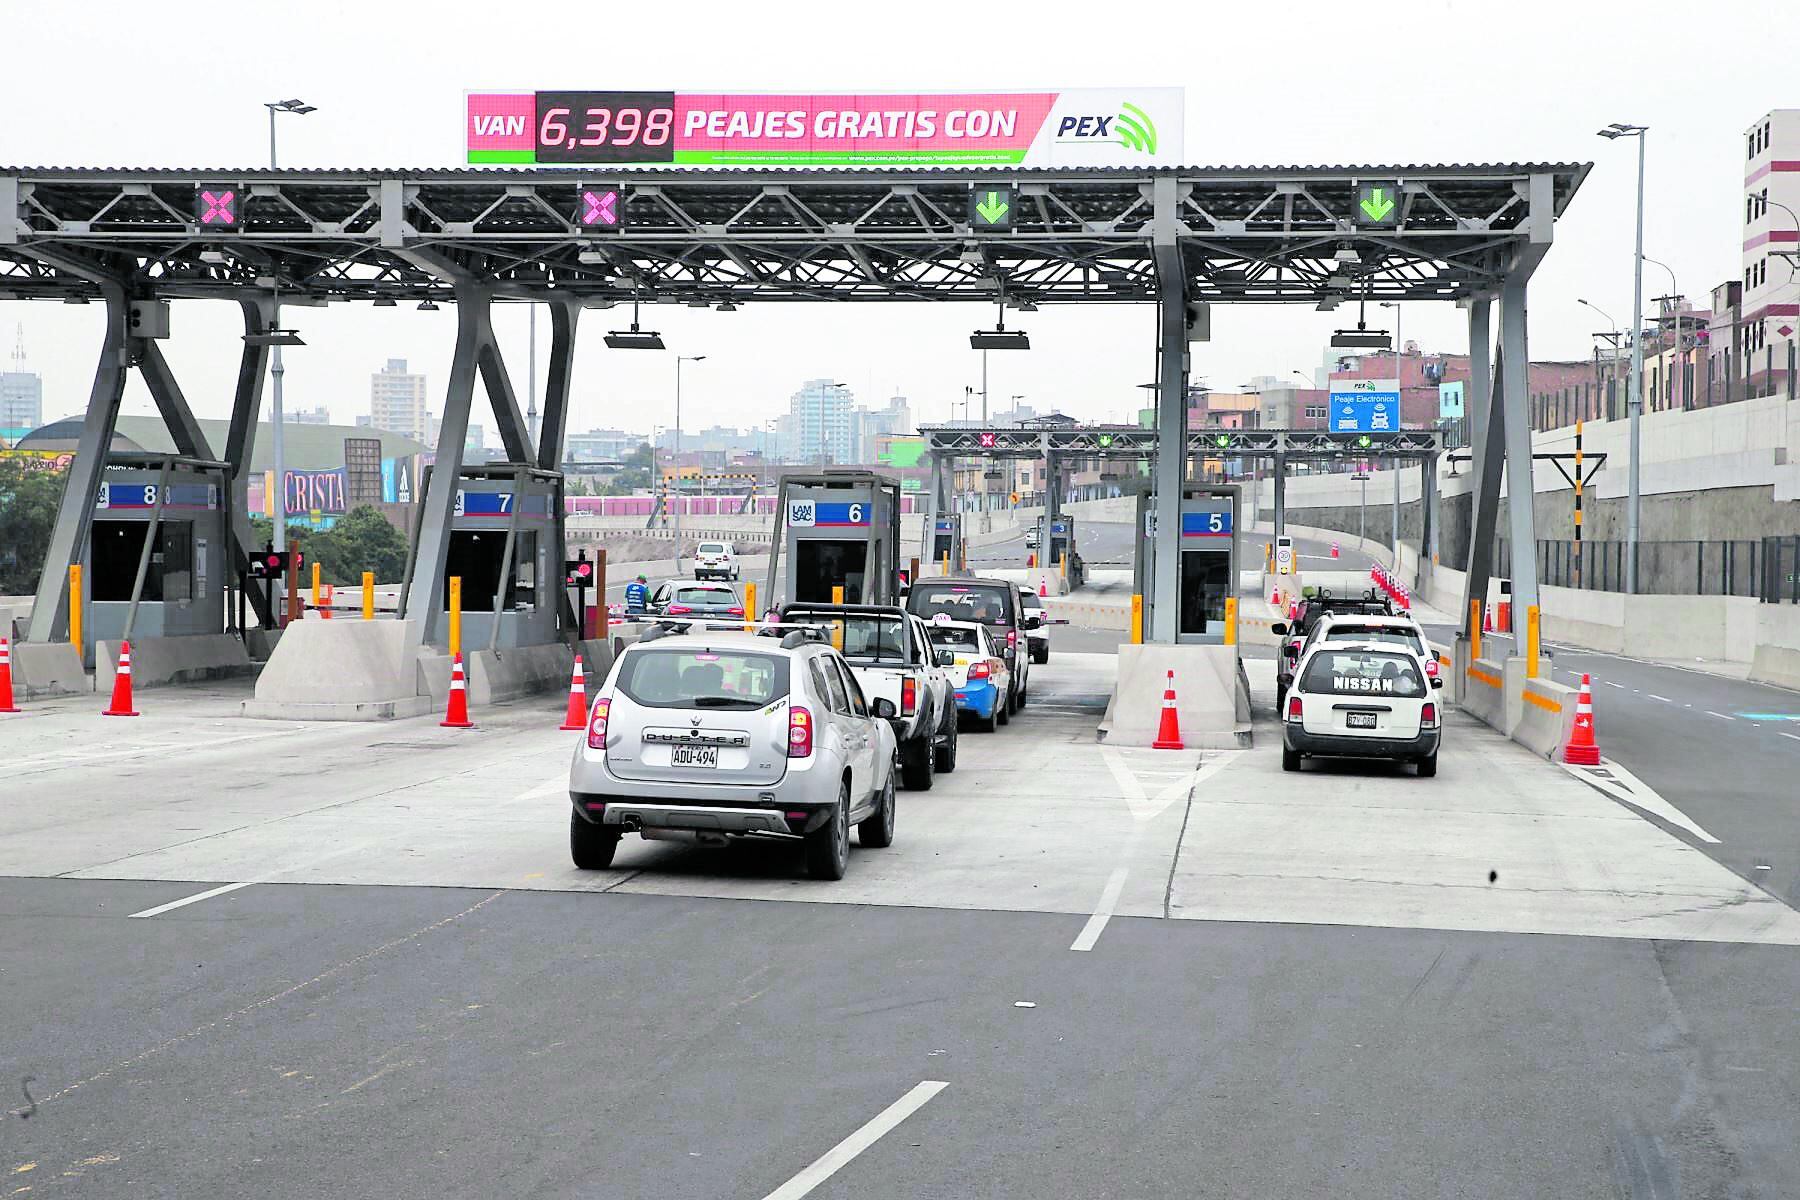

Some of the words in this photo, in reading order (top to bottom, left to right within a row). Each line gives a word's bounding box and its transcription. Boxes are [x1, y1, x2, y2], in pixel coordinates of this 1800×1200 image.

[473, 115, 526, 136] VAN
[540, 108, 673, 149] 6,398
[684, 110, 806, 139] PEAJES
[814, 110, 937, 138] GRATIS
[944, 109, 1018, 138] CON
[1057, 116, 1113, 137] PEX
[1334, 395, 1354, 404] Peaje
[144, 485, 156, 504] 8
[498, 494, 511, 512] 7
[792, 505, 812, 513] LAM
[849, 503, 862, 523] 6
[1209, 513, 1223, 533] 5
[1333, 677, 1393, 691] NISSAN
[646, 733, 745, 744] DUSTER
[673, 750, 715, 764] ADU-494
